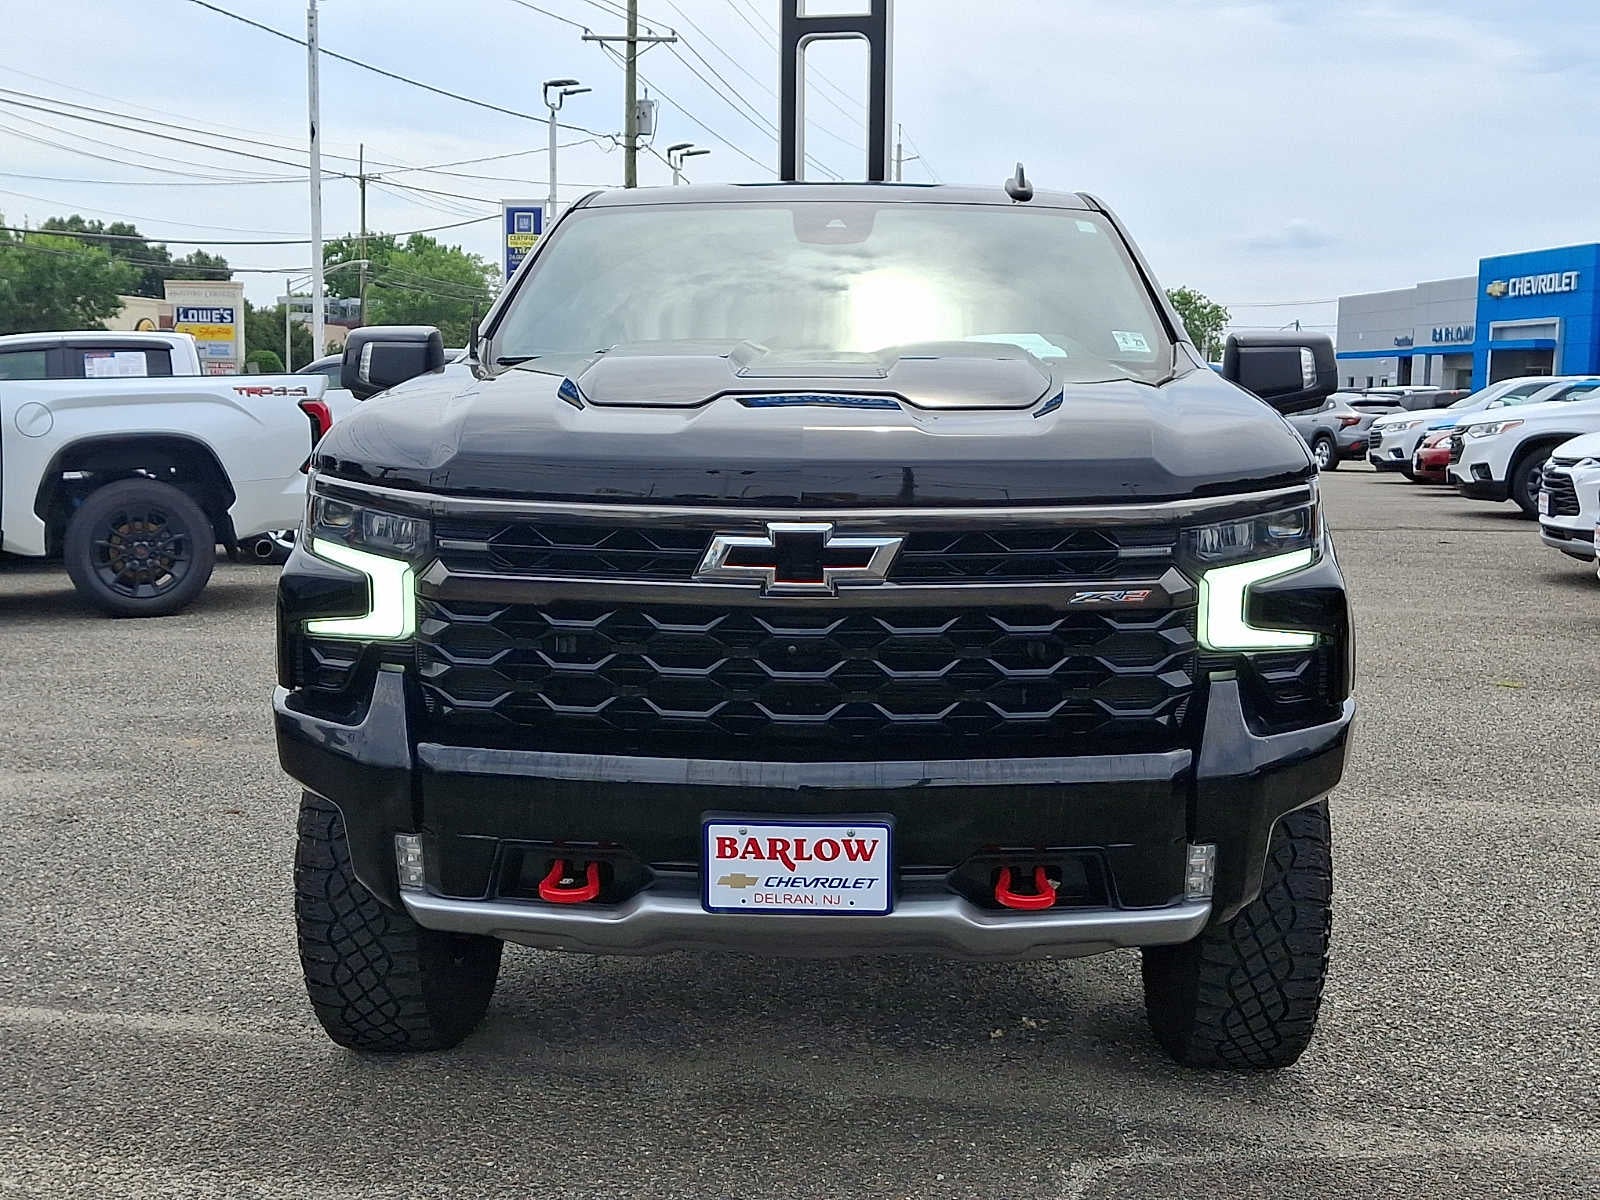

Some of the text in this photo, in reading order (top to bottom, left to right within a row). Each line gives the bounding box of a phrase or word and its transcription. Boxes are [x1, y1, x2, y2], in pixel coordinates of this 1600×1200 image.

[1508, 271, 1579, 296] CHEVROLET
[179, 307, 232, 322] LOWE'S
[1432, 326, 1475, 343] BARLOW
[1068, 590, 1152, 604] ZR2
[715, 836, 879, 872] BARLOW
[764, 876, 880, 889] CHEVROLET
[754, 893, 841, 906] DELRAN, NJ
